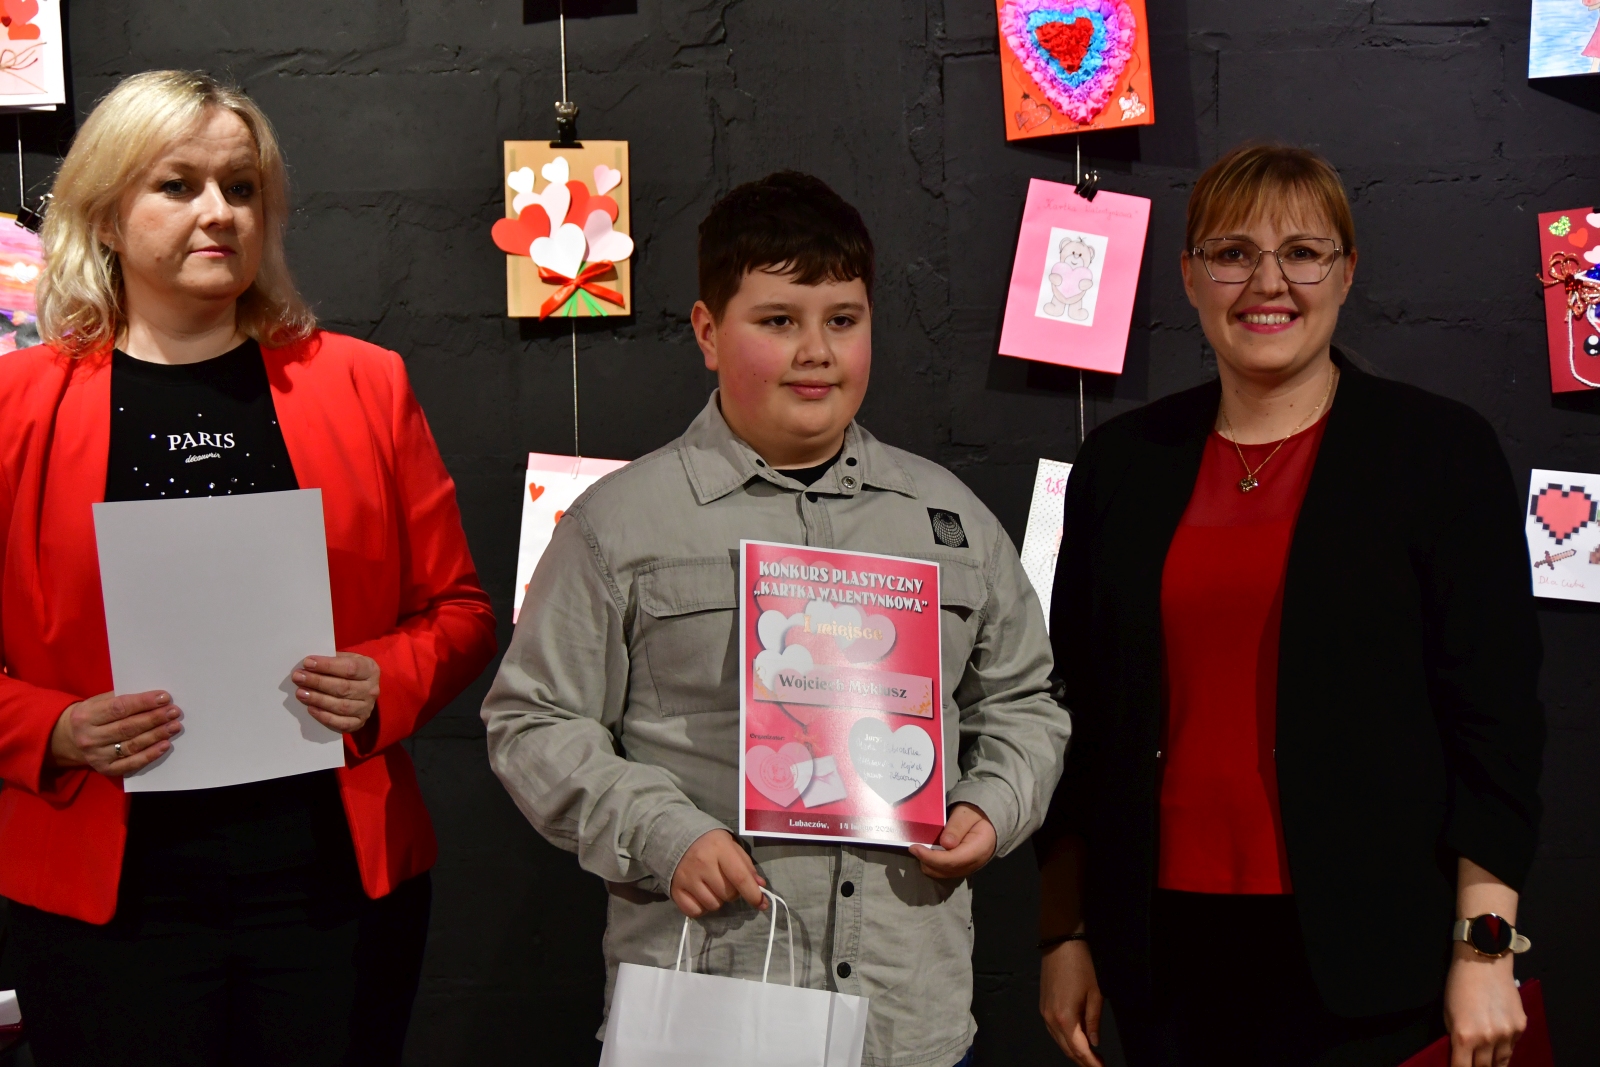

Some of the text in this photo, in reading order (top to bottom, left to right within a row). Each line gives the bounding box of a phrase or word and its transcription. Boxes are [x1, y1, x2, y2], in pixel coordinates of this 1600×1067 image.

[167, 431, 235, 451] PARIS
[759, 561, 923, 593] KONKURS PLASTYCZNY
[804, 615, 883, 641] I miejsce
